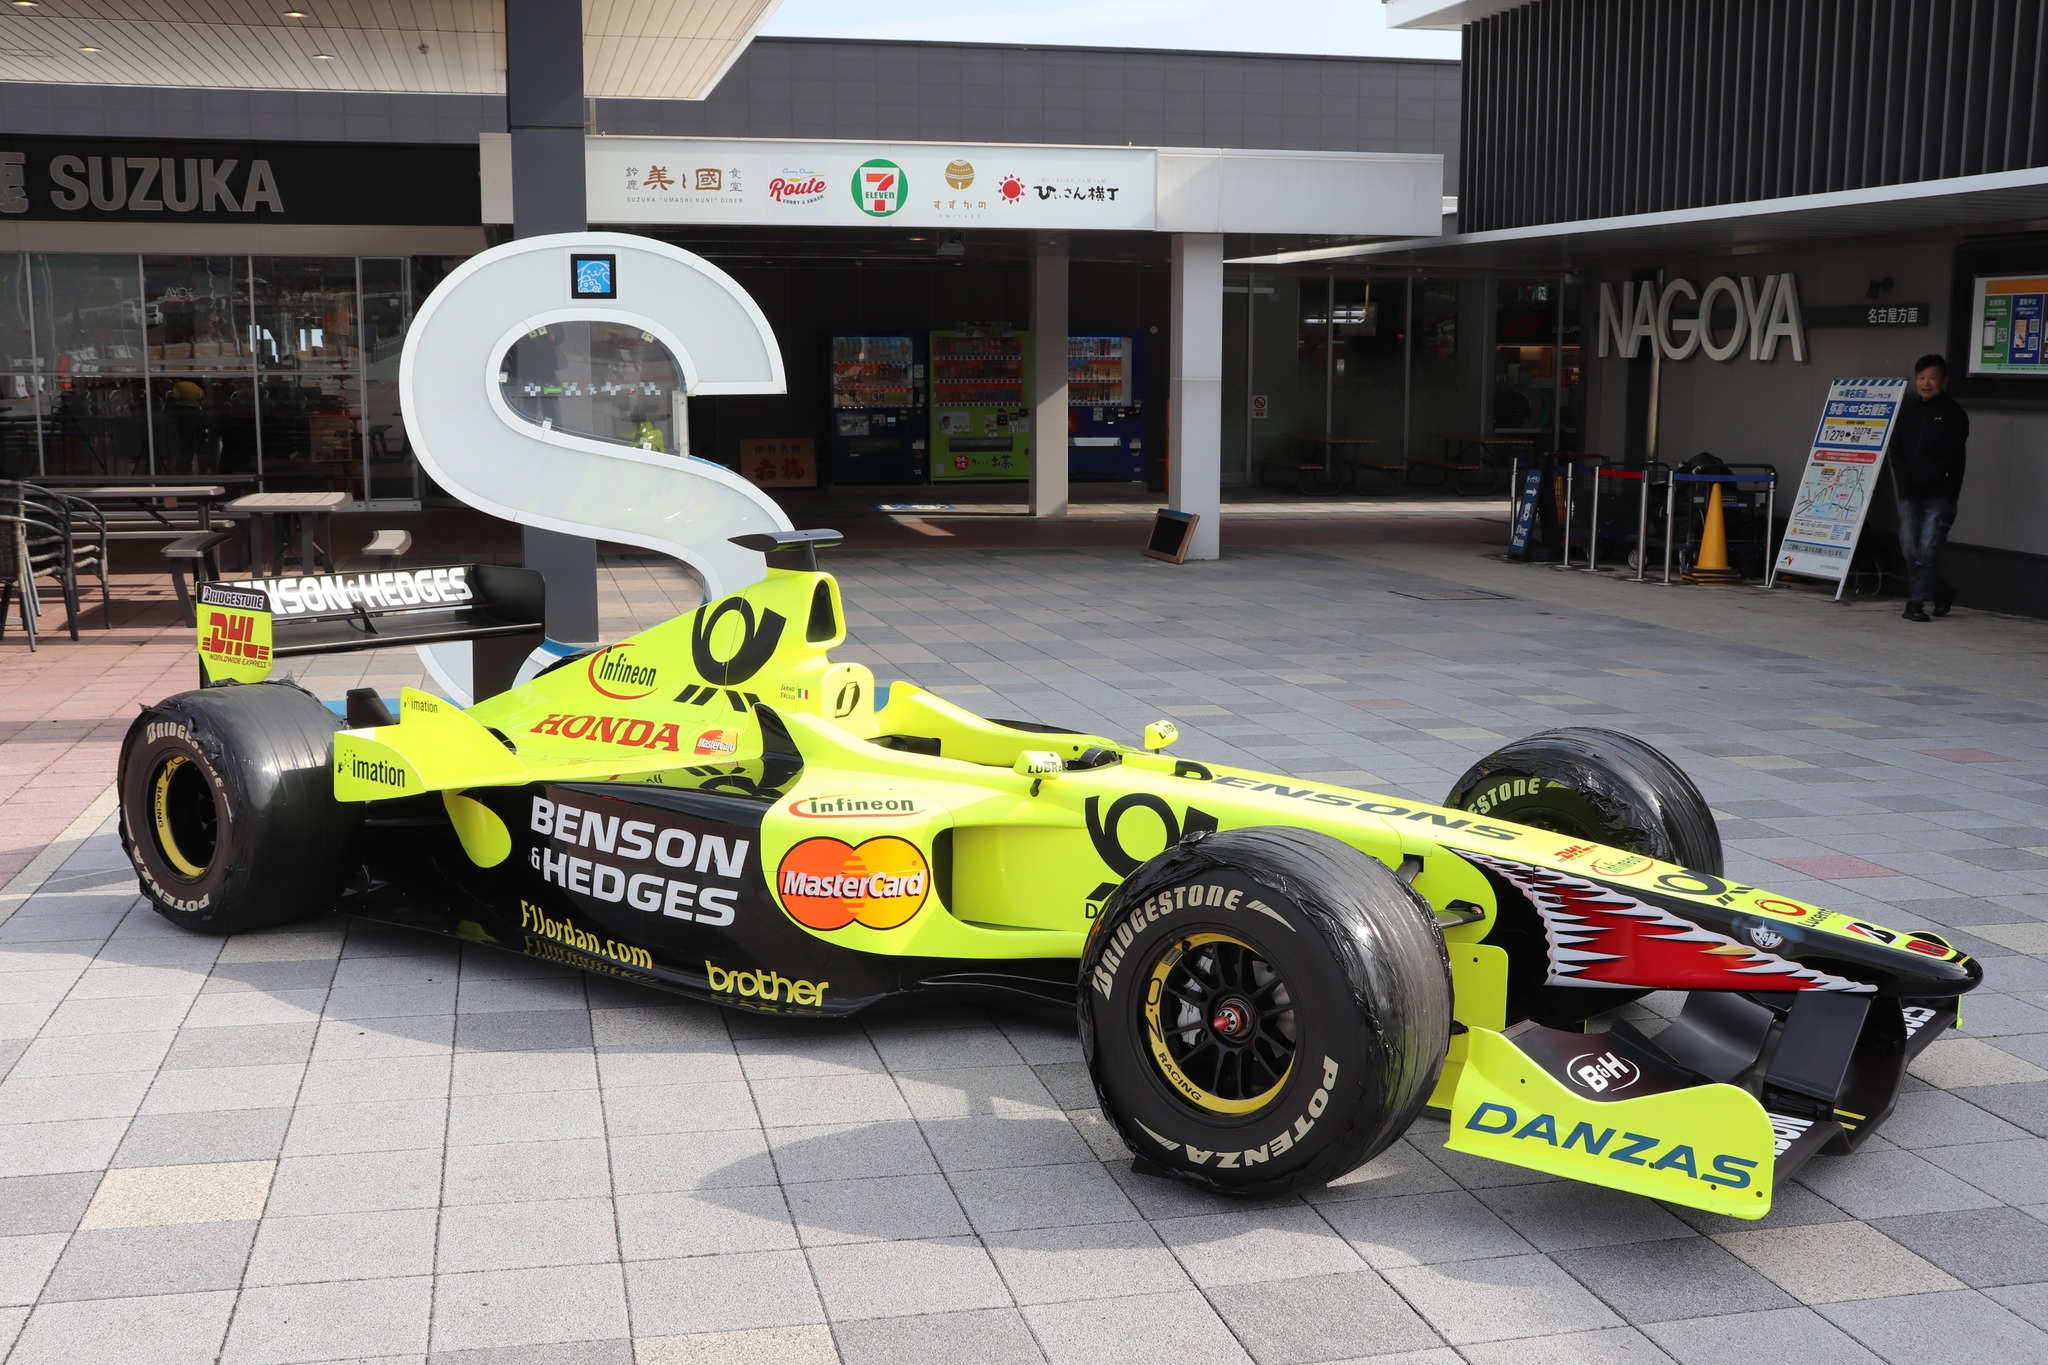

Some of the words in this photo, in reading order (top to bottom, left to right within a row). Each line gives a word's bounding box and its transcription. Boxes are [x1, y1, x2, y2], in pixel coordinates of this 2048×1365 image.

[49, 155, 285, 213] SUZUKA
[626, 167, 639, 190] 鈴鹿
[729, 167, 743, 192] 食堂
[769, 177, 827, 202] Route
[1598, 273, 1806, 361] NAGOYA
[1867, 307, 1919, 324] 名古屋方面
[1513, 536, 1525, 547] Run
[1516, 525, 1528, 536] Dog
[202, 586, 264, 609] BRIDGESTONE
[358, 567, 474, 608] HEDGES
[209, 612, 259, 659] DHL
[209, 654, 241, 665] WORLDWIDE
[242, 658, 267, 668] EXPRESS
[411, 700, 438, 713] imation
[530, 714, 681, 752] HONDA
[697, 737, 736, 753] MasterCard
[353, 753, 405, 788] imation
[156, 786, 164, 829] RACING
[1212, 774, 1524, 841] ENSONS
[530, 795, 750, 879] BENSON
[531, 847, 541, 872] &
[543, 848, 739, 927] HEDGES
[783, 869, 926, 898] MasterCard
[520, 899, 654, 970] F1Jordan.com
[1091, 884, 1244, 1001] BRIDGESTONE
[705, 960, 829, 1007] brother
[1158, 1052, 1202, 1101] RACING
[1577, 1051, 1630, 1093] B&H
[1184, 1055, 1339, 1169] POTENZA
[1465, 1100, 1759, 1190] DANZAS
